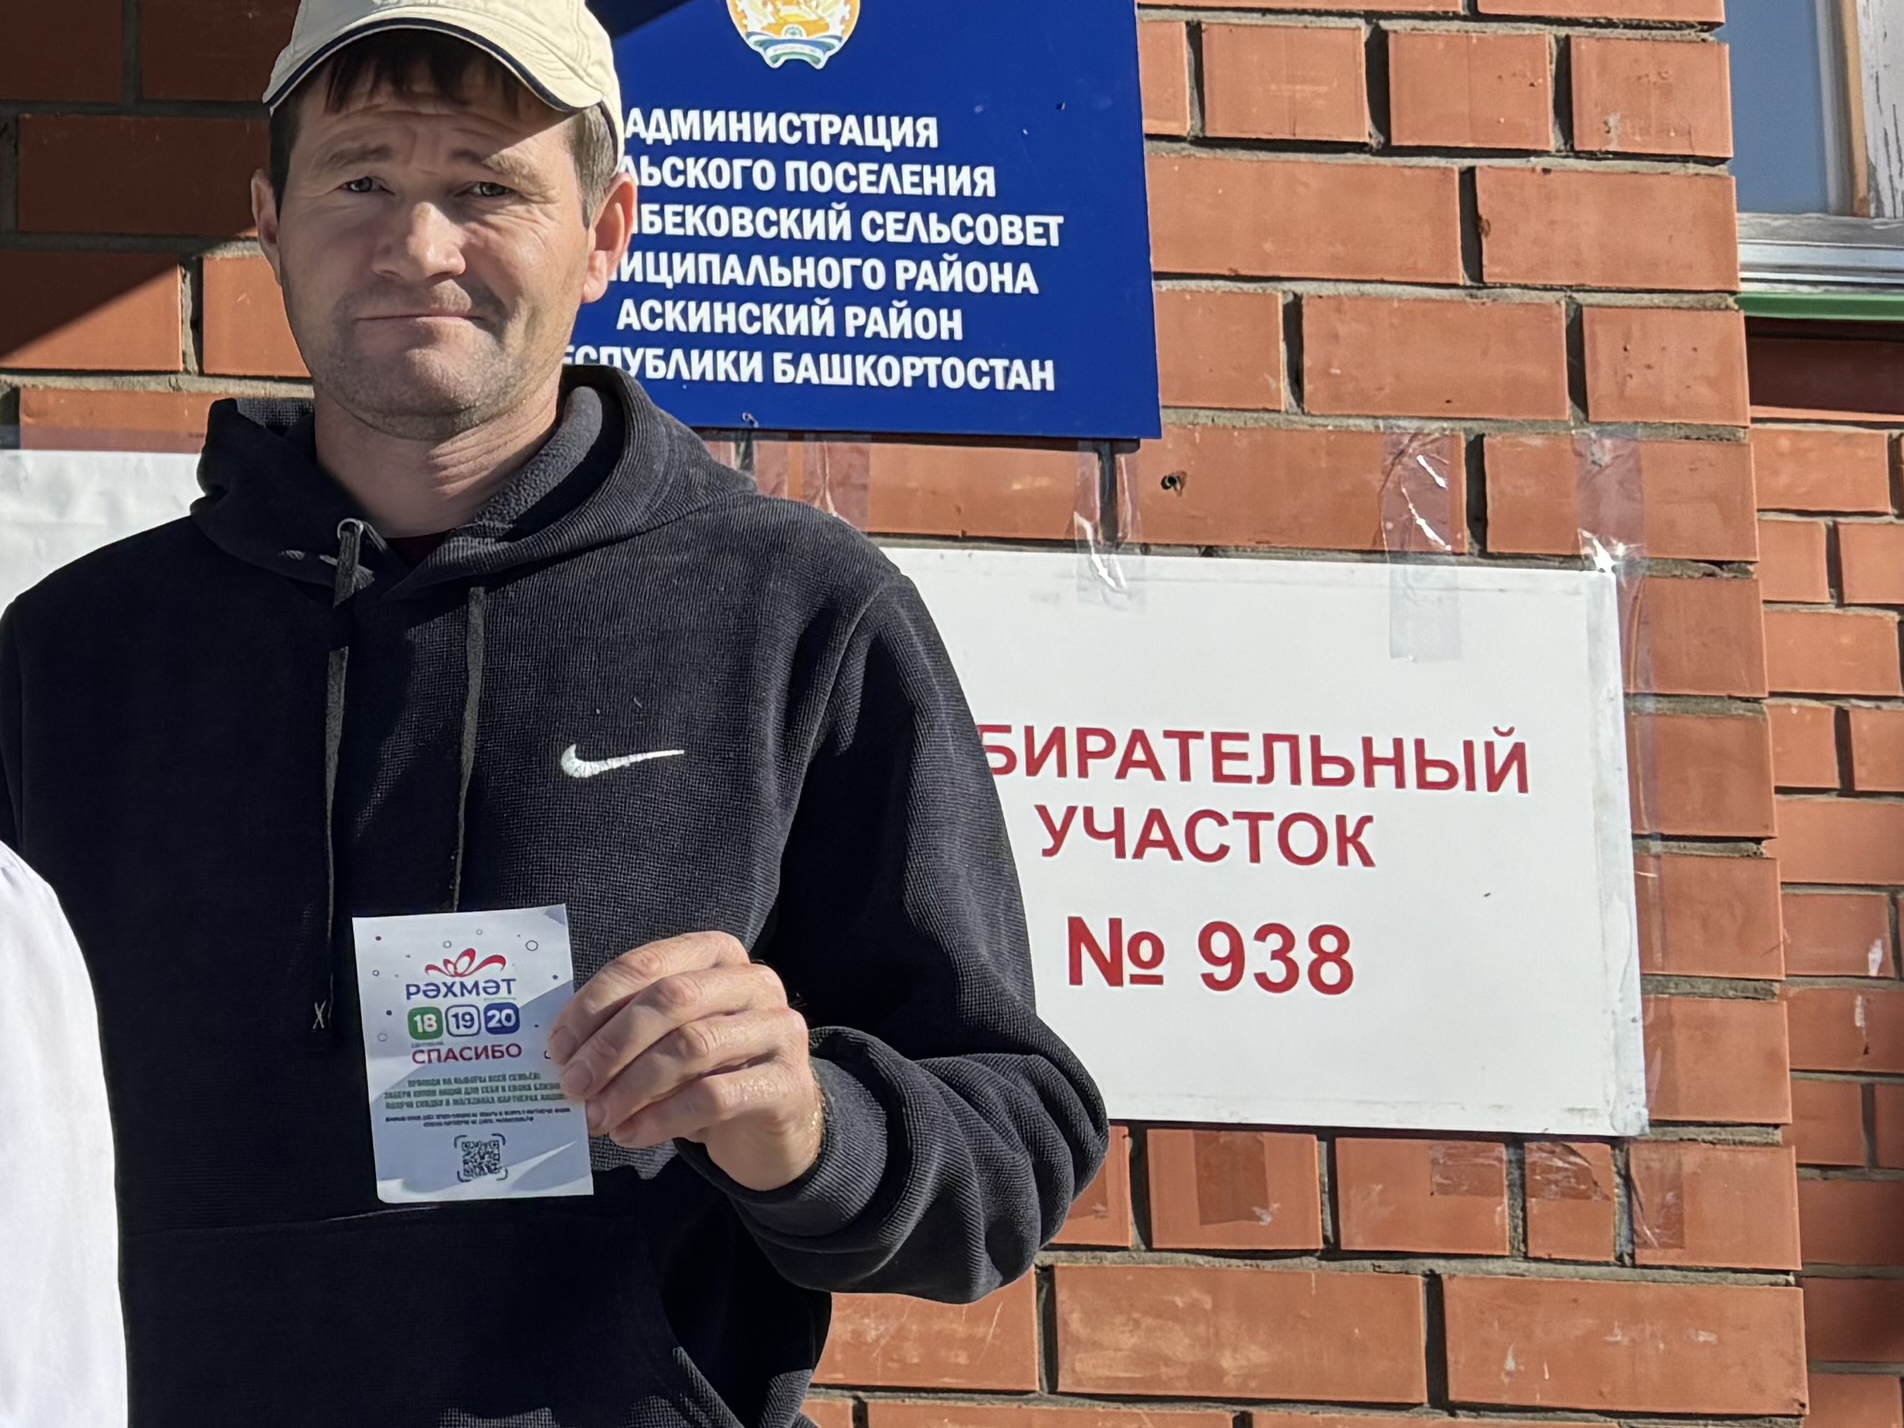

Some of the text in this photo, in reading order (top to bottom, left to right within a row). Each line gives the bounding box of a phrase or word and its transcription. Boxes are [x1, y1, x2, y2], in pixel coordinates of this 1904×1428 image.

[625, 107, 939, 153] АДМИНИСТРАЦИЯ
[620, 155, 996, 199] ЛЬСКОГО ПОСЕЛЕНИЯ
[633, 202, 1065, 248] БЕКОВСКИЙ СЕЛЬСОВЕТ
[609, 250, 1040, 296] ИЦИПАЛЬНОГО РАЙОНА
[616, 297, 964, 341] АСКИНСКИЙ РАЙОН
[772, 351, 1056, 392] БАШКОРТОСТАН
[977, 724, 1530, 794] БИРАТЕЛЬНЫЙ
[1034, 804, 1376, 868] УЧАСТОК
[1067, 916, 1355, 996] № 938
[405, 978, 516, 1001] РӘХМӘТ
[413, 1008, 516, 1033] 18 19 20
[412, 1042, 523, 1064] СПАСИБО
